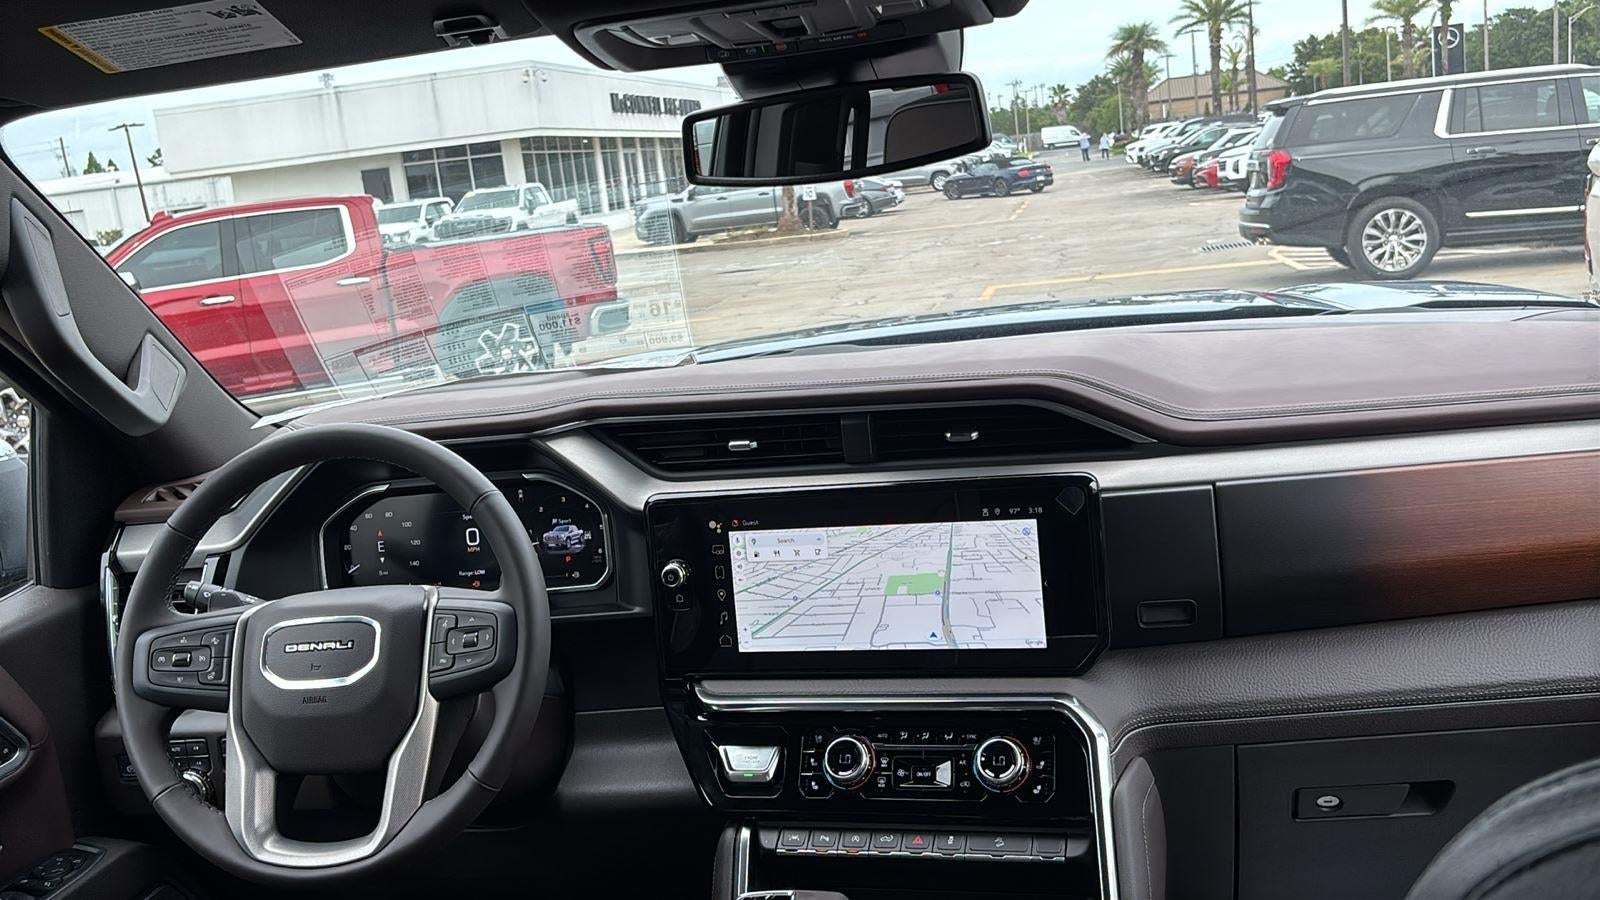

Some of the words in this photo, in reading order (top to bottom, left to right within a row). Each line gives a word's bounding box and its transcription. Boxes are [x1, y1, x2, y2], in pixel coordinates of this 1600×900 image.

[466, 527, 480, 545] 0
[377, 540, 385, 553] E
[284, 640, 354, 653] DENALI
[302, 695, 328, 704] AIRBAG
